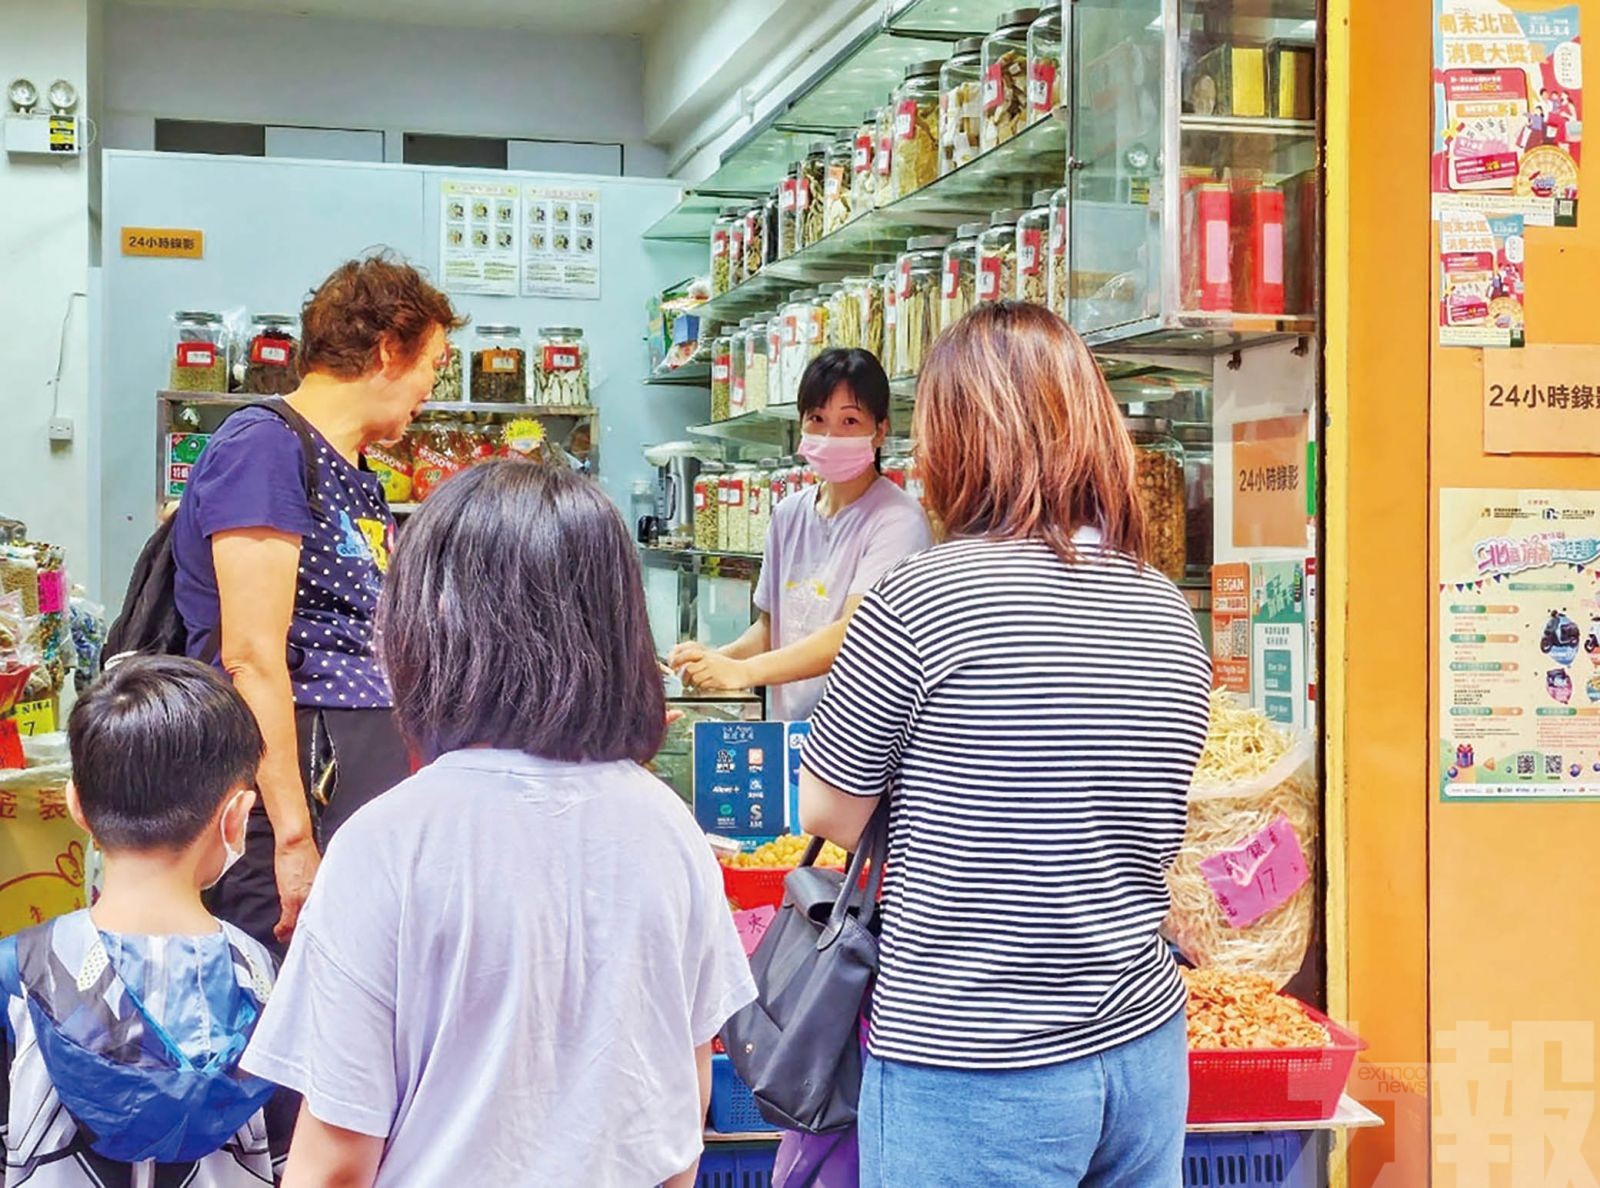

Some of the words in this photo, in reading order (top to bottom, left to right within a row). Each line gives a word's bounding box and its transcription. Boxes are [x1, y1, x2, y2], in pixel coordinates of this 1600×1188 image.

[129, 236, 195, 250] 24小時錄影
[1489, 384, 1600, 409] 24小時錄
[1240, 465, 1299, 492] 24小時錄影
[23, 720, 35, 737] 7
[1255, 867, 1277, 900] 17
